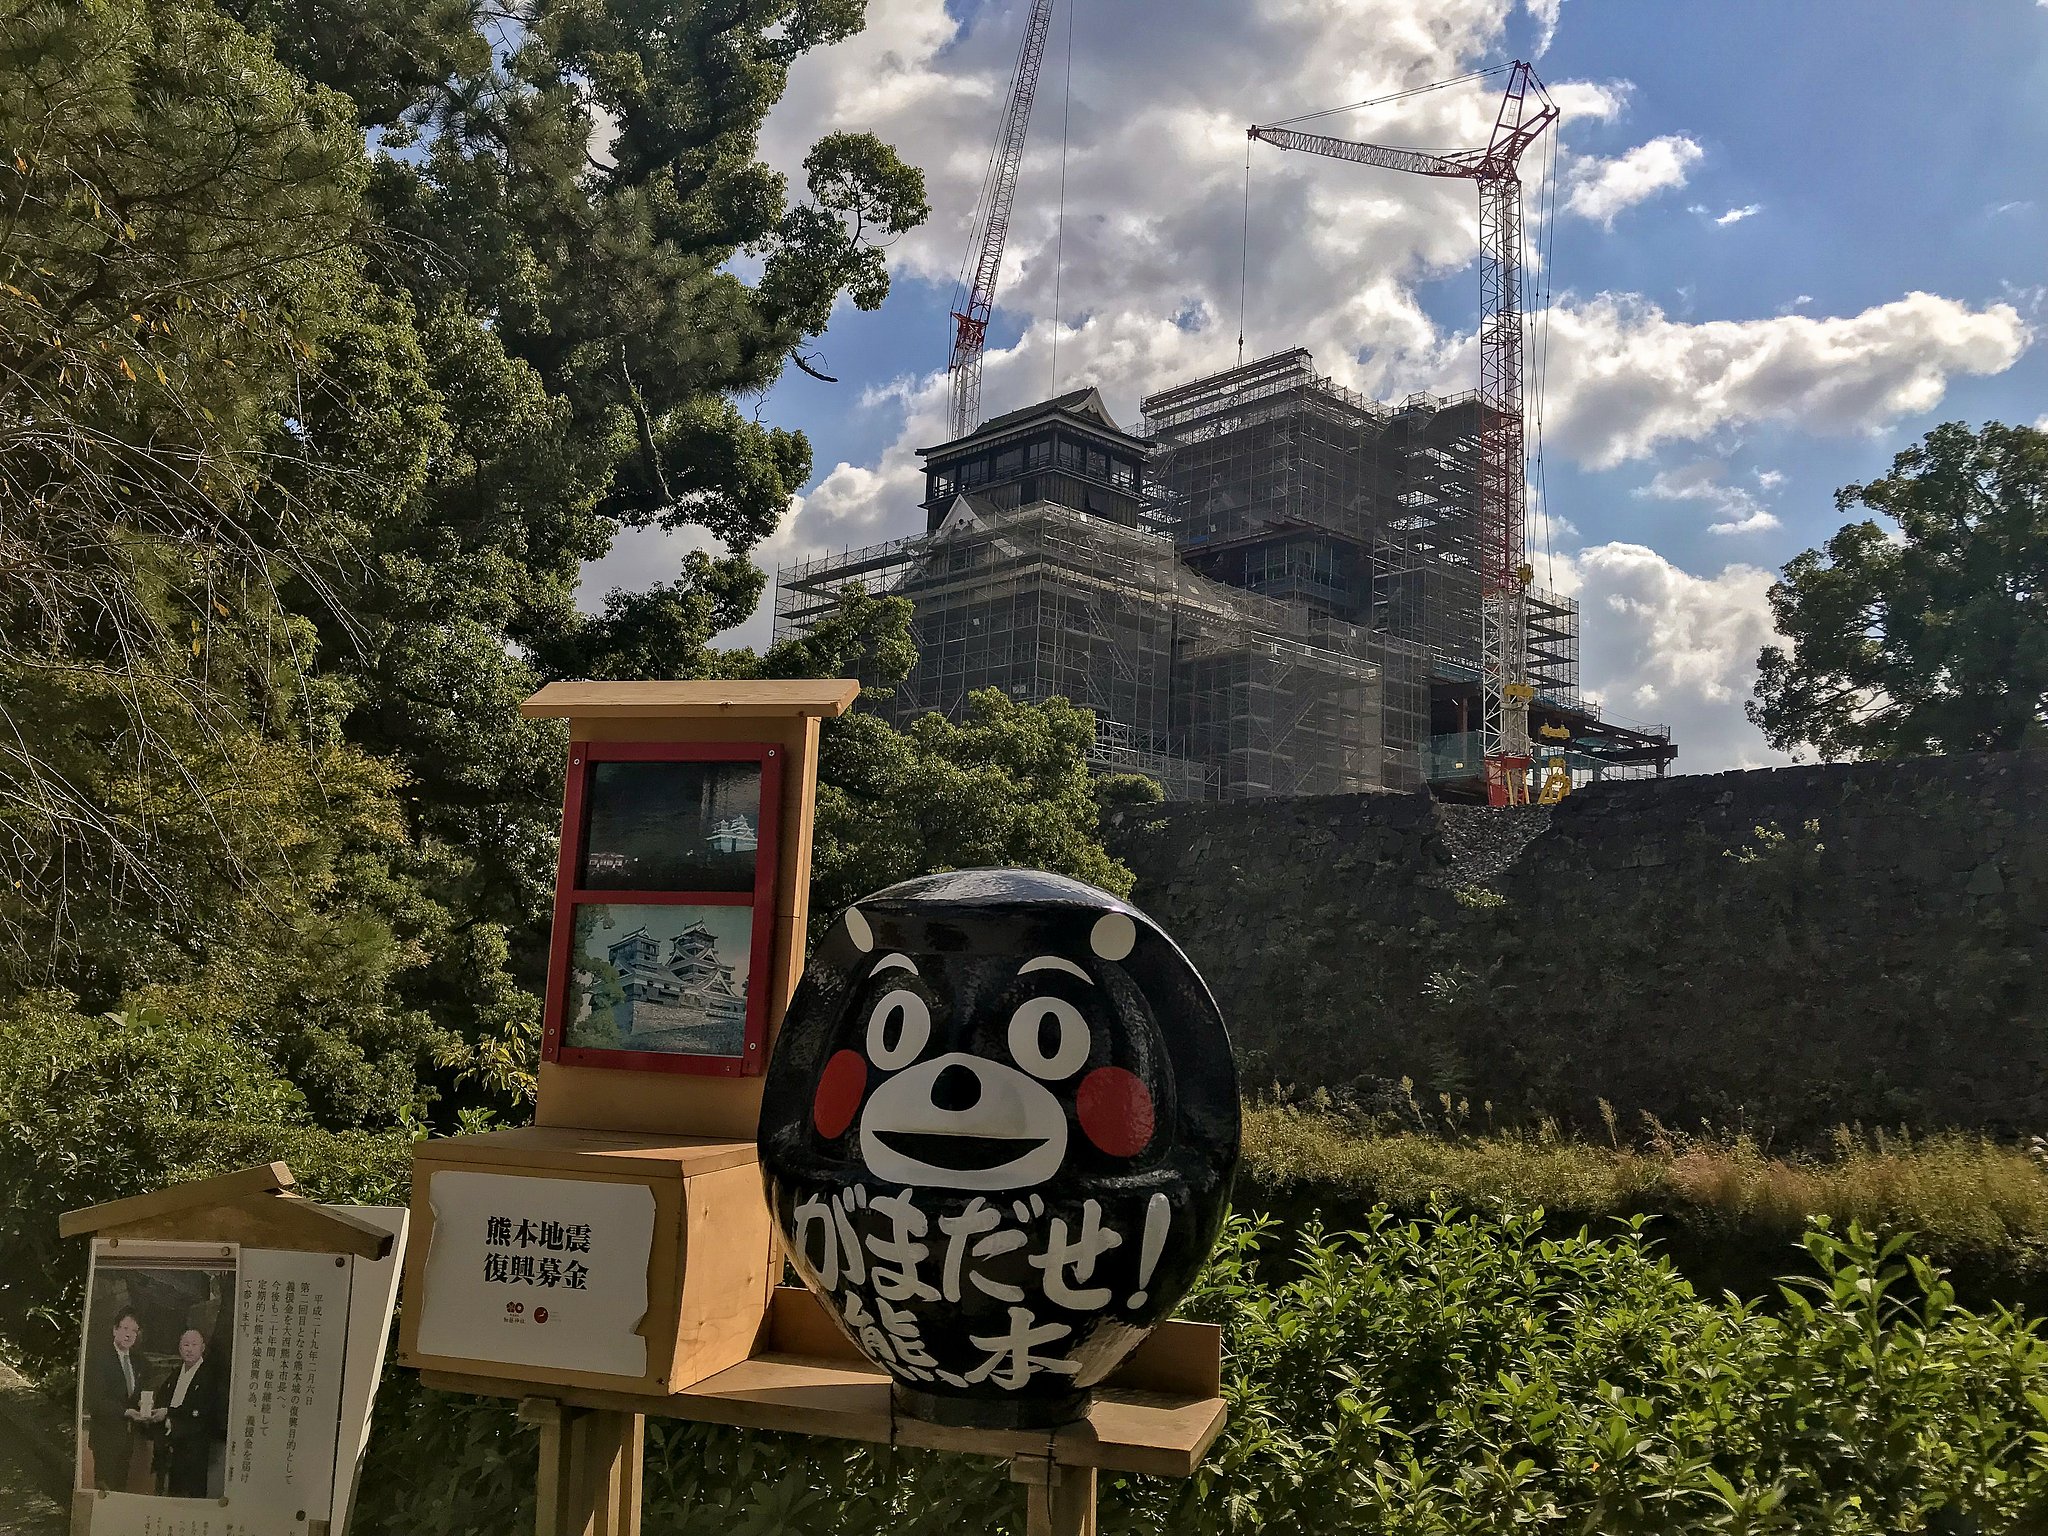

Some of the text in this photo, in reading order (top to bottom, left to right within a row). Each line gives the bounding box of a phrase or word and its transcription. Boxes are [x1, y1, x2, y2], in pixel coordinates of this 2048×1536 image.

[483, 1252, 590, 1291] 復興募金
[485, 1215, 592, 1254] 熊本地震
[793, 1183, 1172, 1311] がまだせ!
[305, 1294, 324, 1406] 平成二十九年二月六日
[843, 1289, 1084, 1391] 熊本
